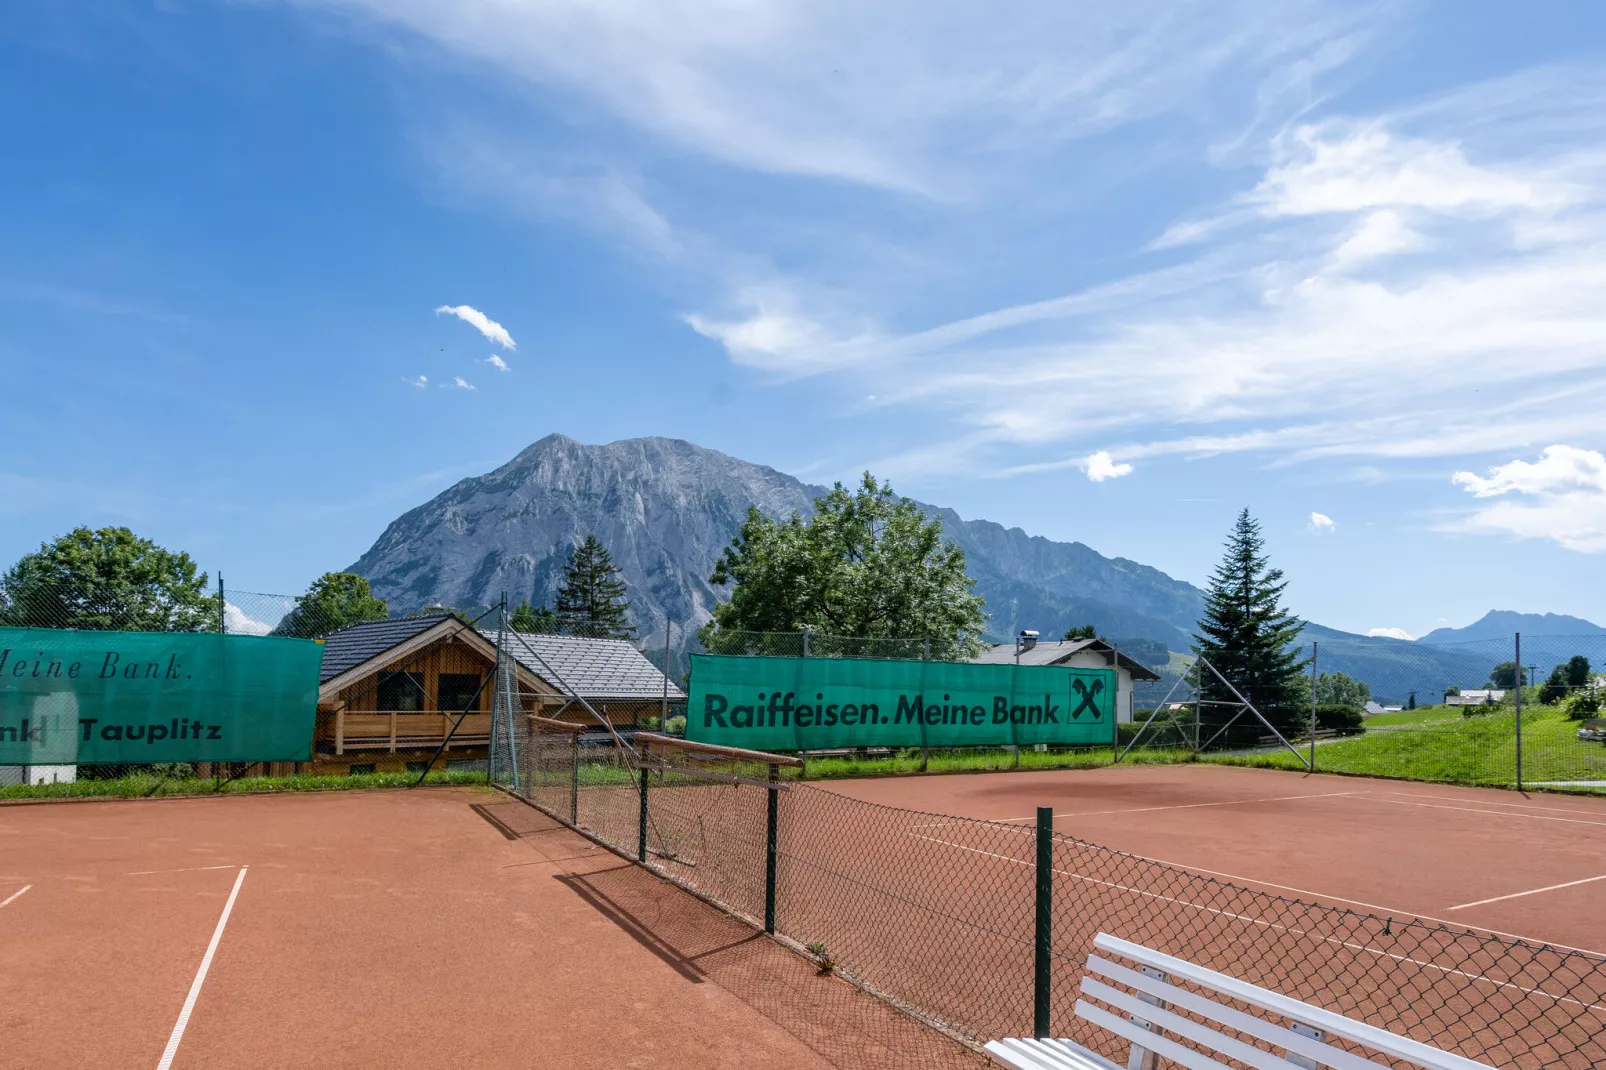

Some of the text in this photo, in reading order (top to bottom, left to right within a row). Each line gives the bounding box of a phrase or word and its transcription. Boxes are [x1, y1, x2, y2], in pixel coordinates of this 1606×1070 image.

[100, 652, 192, 680] Bank.
[704, 692, 1060, 728] Raiffeisen. Meine Bank
[78, 718, 222, 744] Tauplitz
